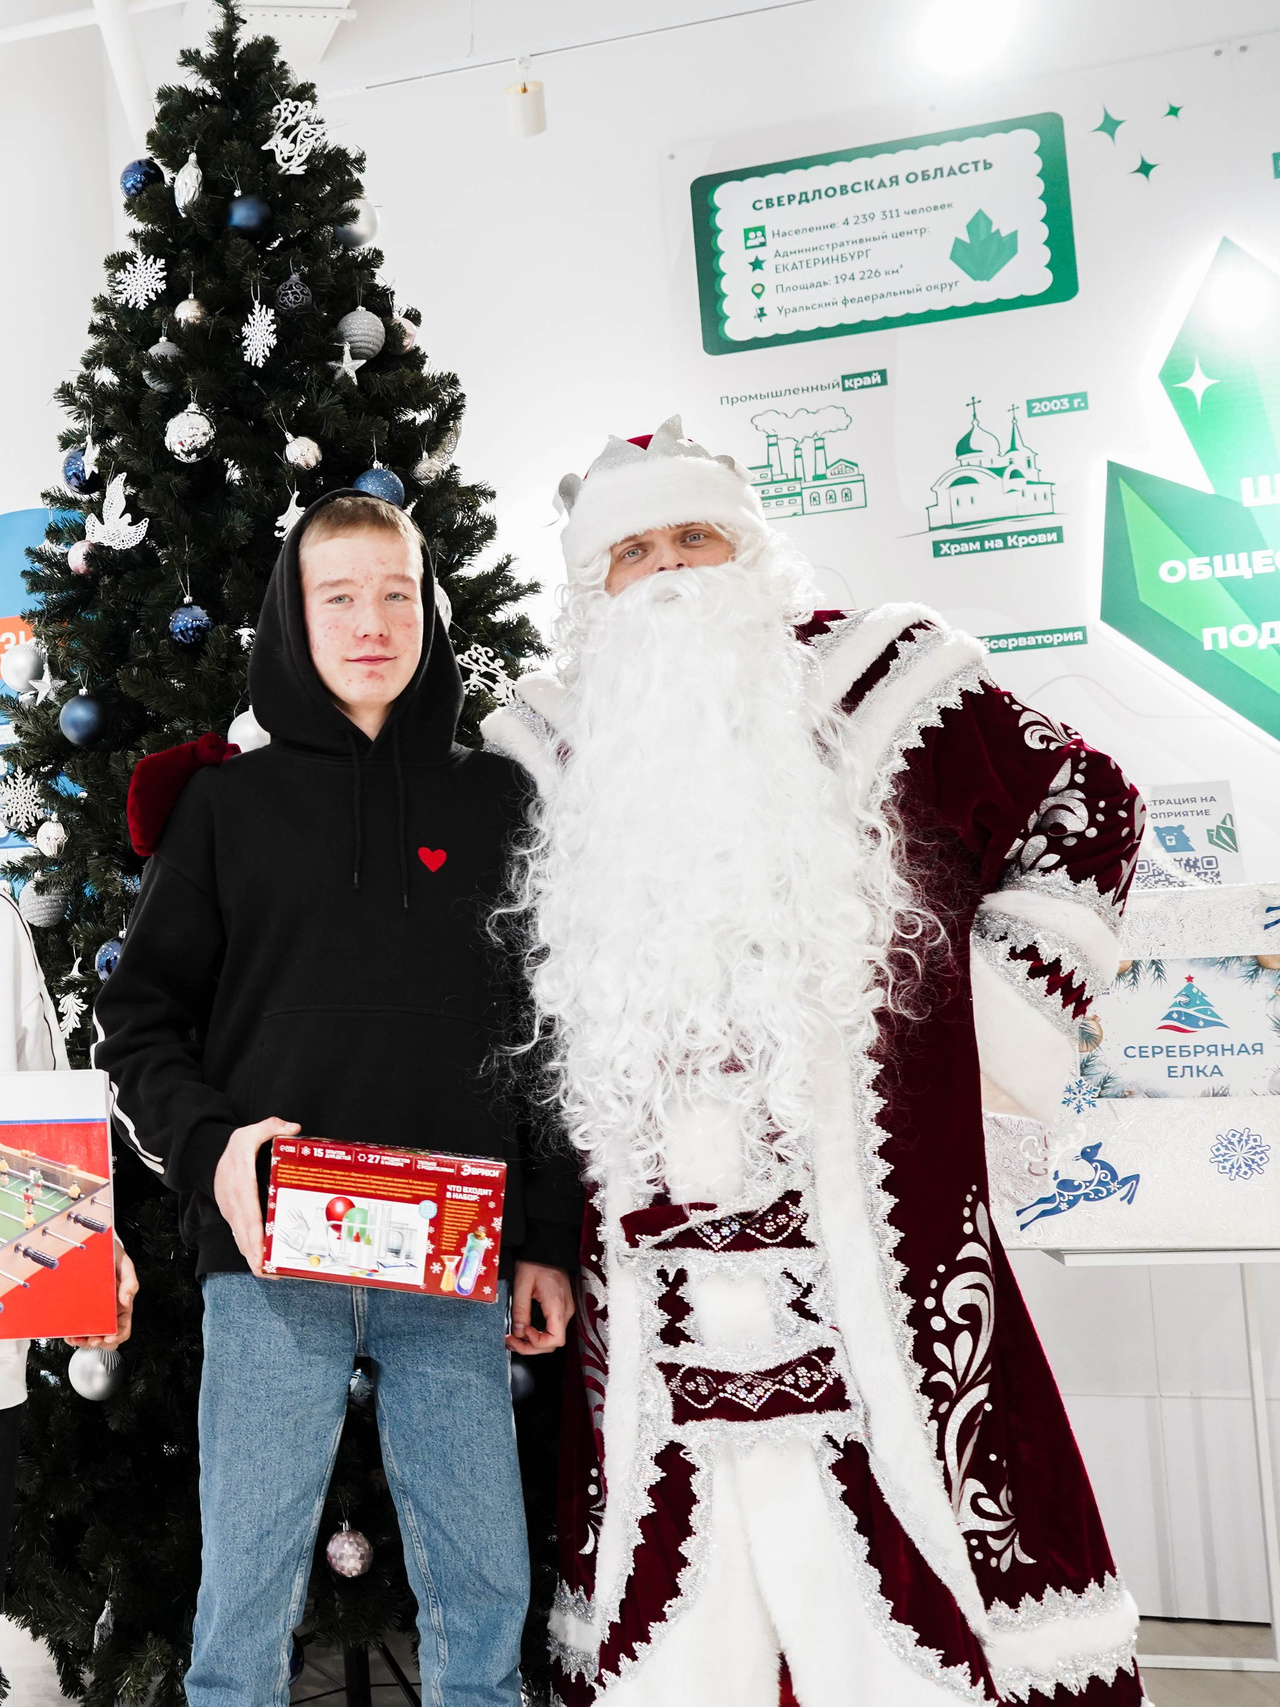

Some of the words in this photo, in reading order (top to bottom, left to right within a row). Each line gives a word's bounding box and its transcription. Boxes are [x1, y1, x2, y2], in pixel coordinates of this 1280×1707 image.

[752, 175, 899, 211] СВЕРДЛОВСКАЯ
[905, 159, 993, 184] ОБЛАСТЬ
[771, 222, 839, 239] Население:
[842, 218, 850, 227] 4
[854, 212, 876, 225] 239
[881, 208, 900, 221] 311
[904, 202, 953, 216] человек
[774, 231, 888, 259] Административный
[891, 227, 930, 239] центр:
[775, 249, 871, 274] ЕКАТЕРИНБУРГ
[775, 280, 832, 294] Площадь:
[835, 273, 855, 285] 194
[860, 268, 881, 281] 226
[777, 297, 838, 317] Уральский
[841, 284, 923, 307] федеральный
[925, 280, 960, 293] округ
[720, 379, 841, 406] Промышленный
[844, 372, 882, 390] край
[1031, 398, 1070, 414] 2003
[1073, 398, 1085, 408] г.
[939, 540, 981, 556] Храм
[984, 538, 1004, 550] на
[1007, 531, 1058, 548] Крови
[1200, 795, 1217, 804] НА
[1123, 1042, 1264, 1059] СЕРЕБРЯНАЯ
[1167, 1064, 1224, 1079] ЕЛКА
[313, 1147, 324, 1158] 15
[367, 1154, 380, 1164] 27
[446, 1184, 462, 1192] ЧТО
[462, 1186, 493, 1196] ВХОДИТ
